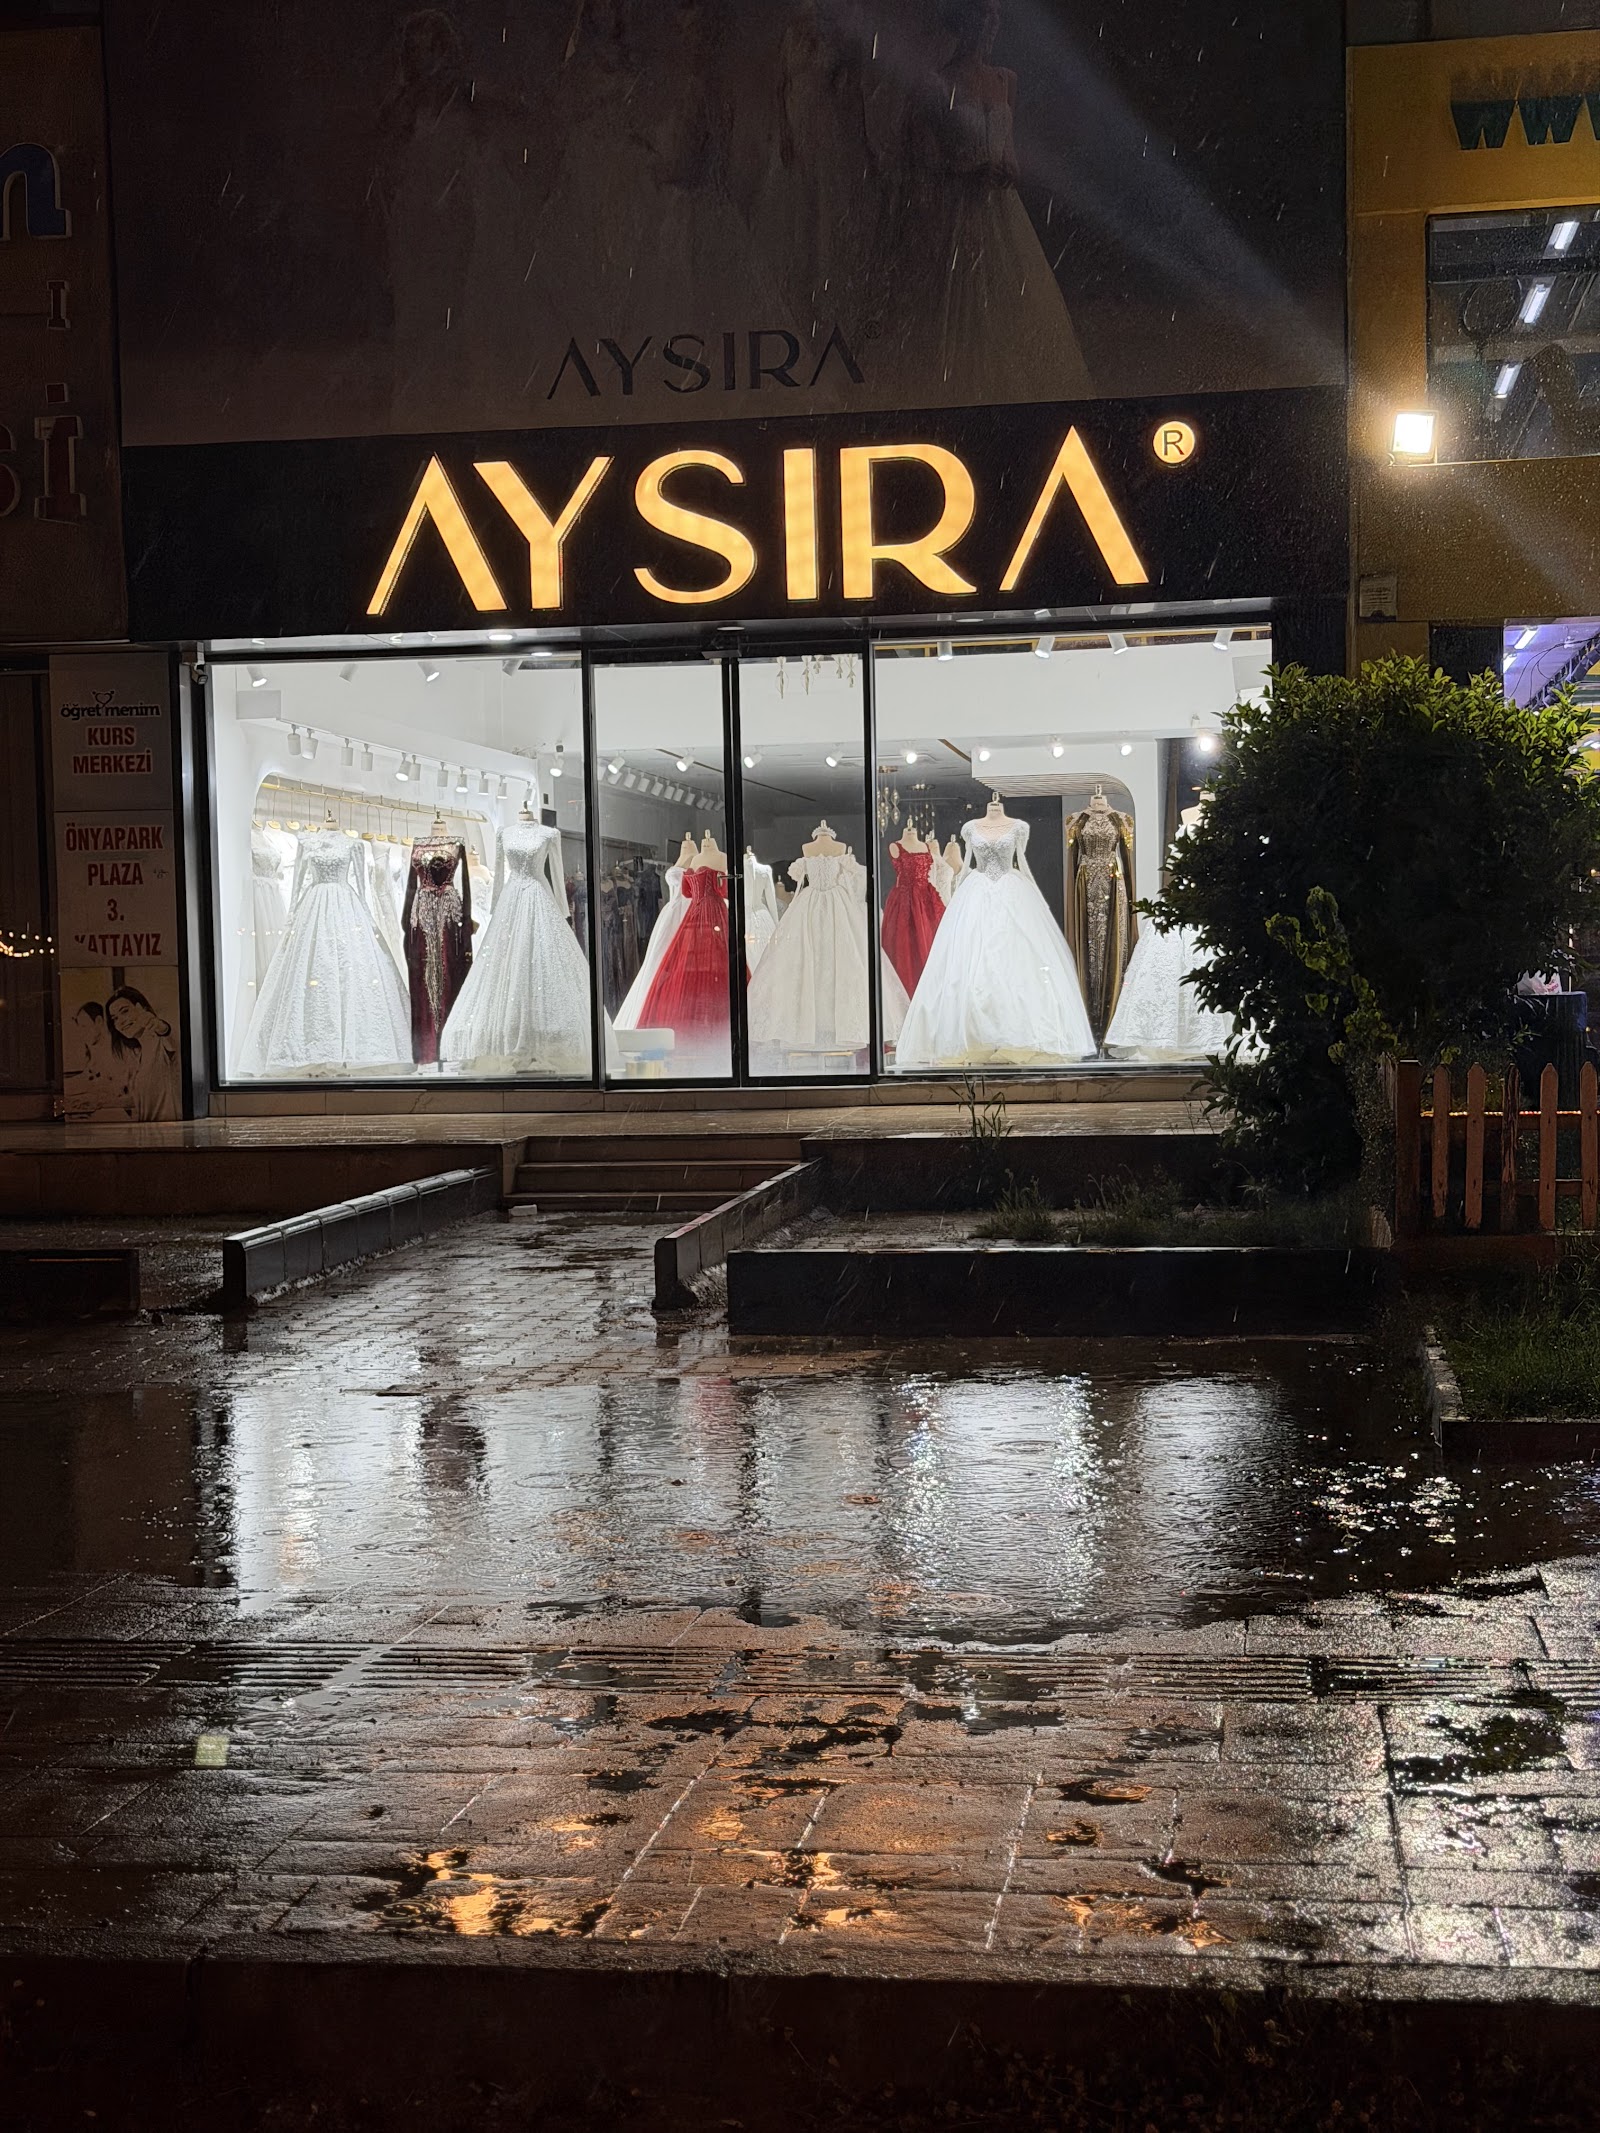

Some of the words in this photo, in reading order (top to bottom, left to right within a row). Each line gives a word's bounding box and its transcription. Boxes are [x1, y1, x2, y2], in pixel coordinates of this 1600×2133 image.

[547, 323, 866, 400] AYSIRA
[366, 424, 1151, 617] AYSIRA
[88, 727, 135, 746] KURS
[73, 749, 151, 774] MERKEZİ
[66, 822, 163, 851] ÖNYAPARK
[88, 862, 143, 886] PLAZA
[107, 898, 125, 921] 3.
